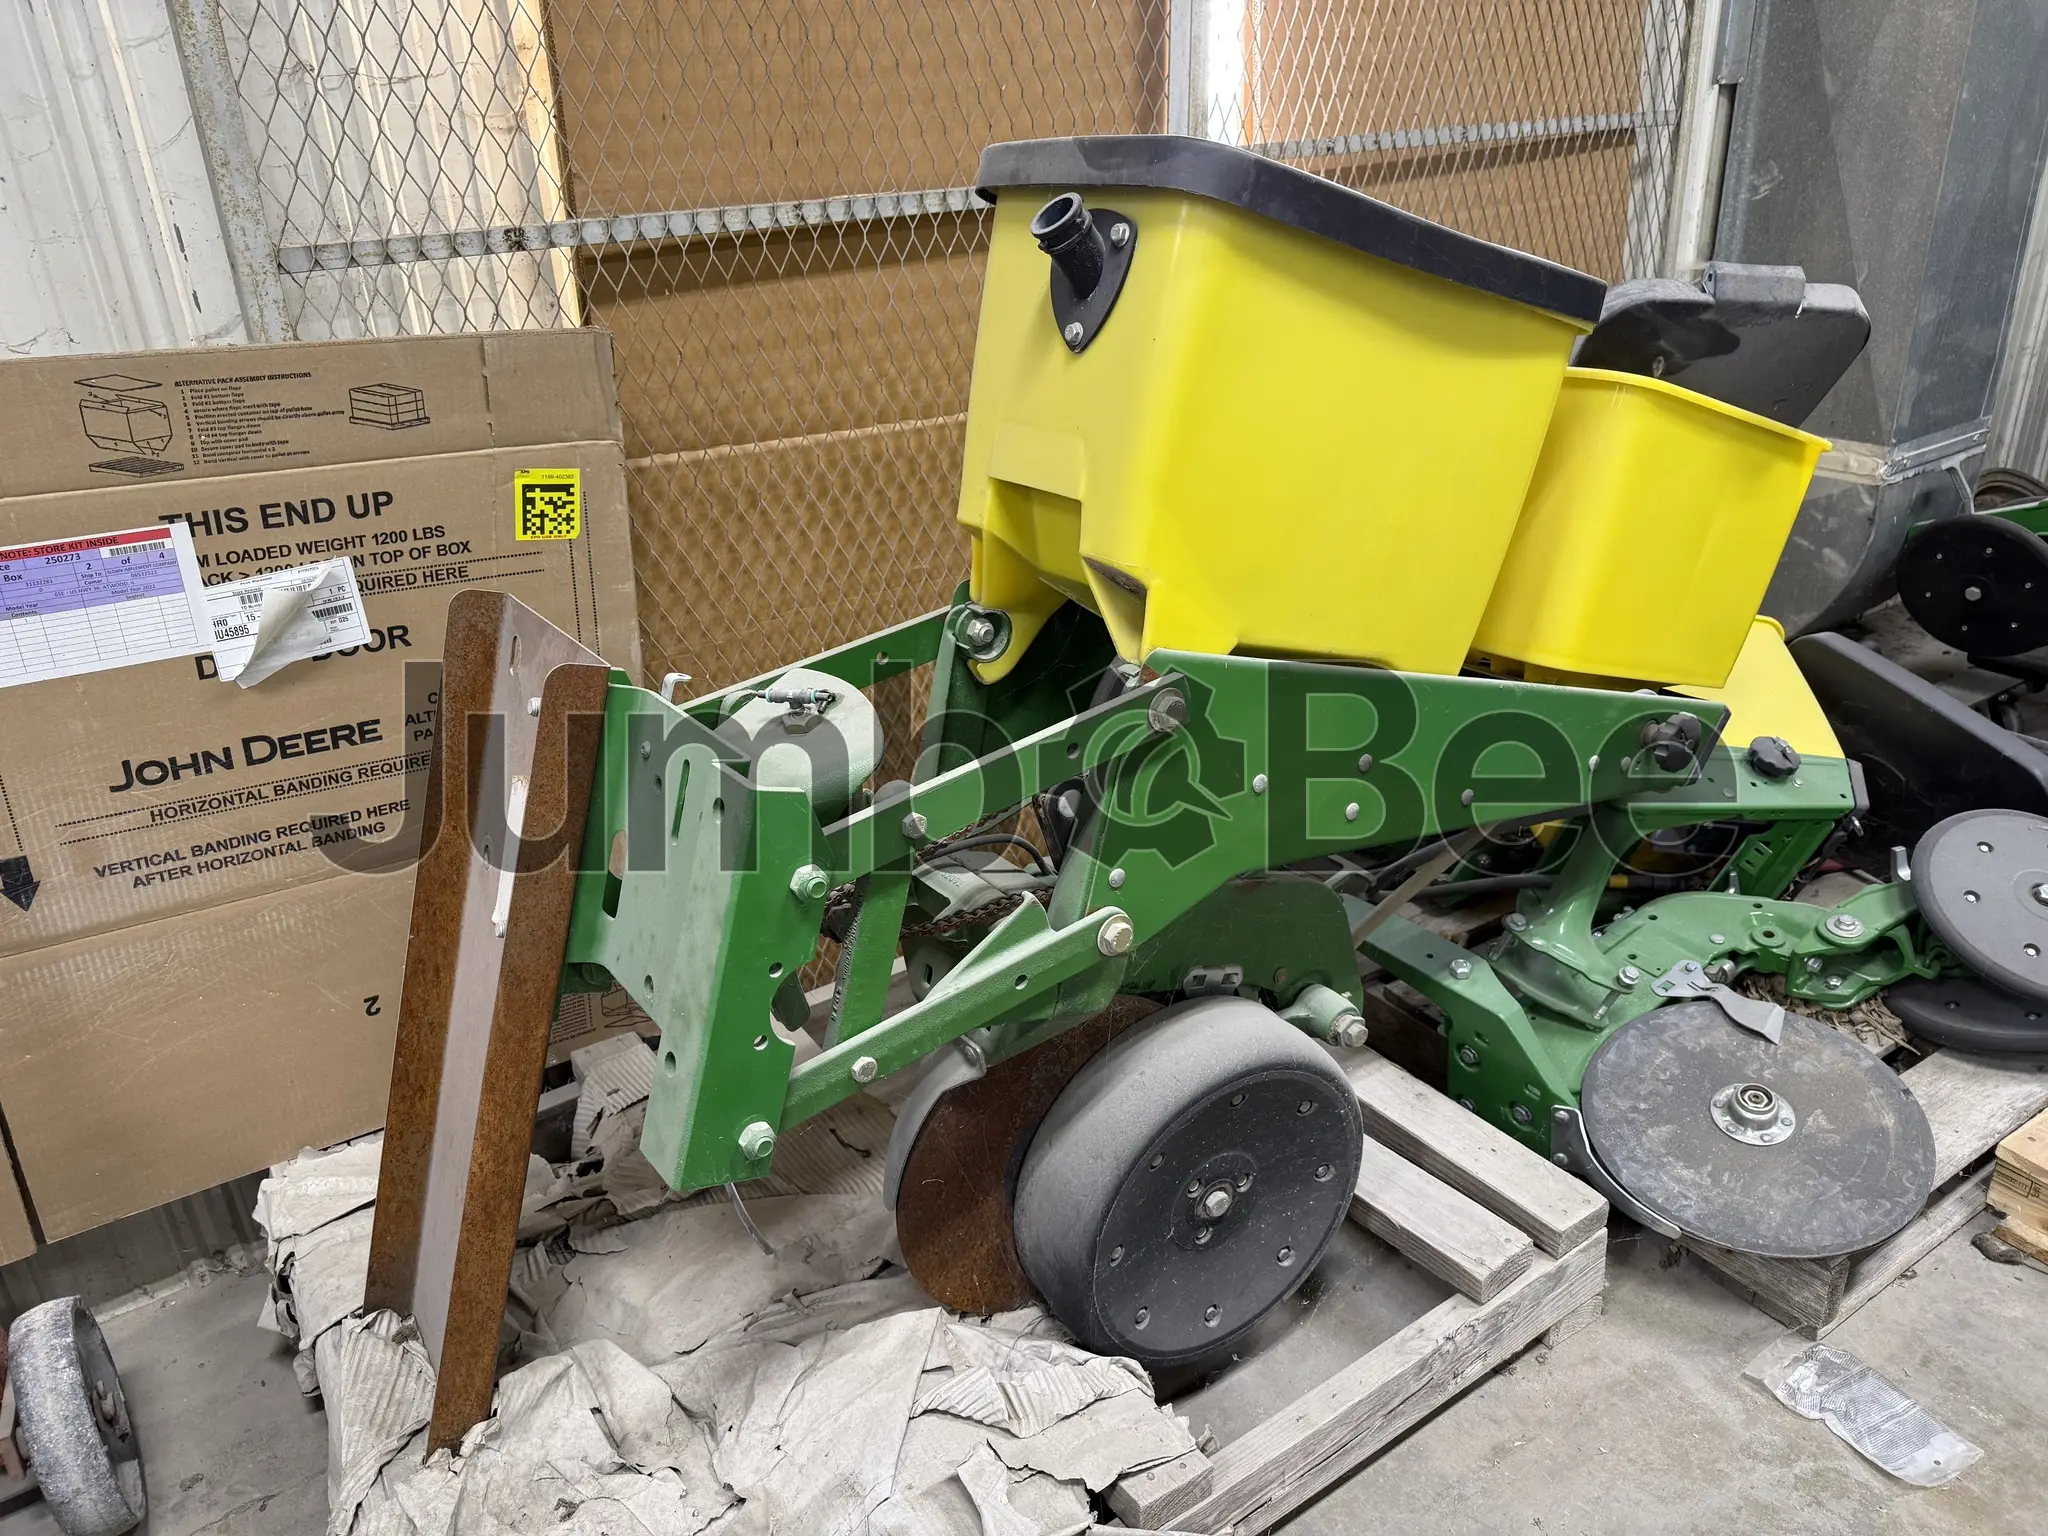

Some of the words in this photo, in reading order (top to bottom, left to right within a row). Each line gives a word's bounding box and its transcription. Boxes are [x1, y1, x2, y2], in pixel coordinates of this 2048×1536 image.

[234, 375, 266, 383] ASSEMBLY
[267, 372, 312, 380] INSTRUCTIONS
[158, 507, 250, 538] THIS
[259, 497, 336, 529] END
[346, 491, 394, 519] UP
[0, 549, 31, 560] NOTE:
[33, 544, 68, 556] STORE
[69, 541, 85, 550] KIT
[86, 536, 119, 548] INSIDE
[214, 544, 292, 566] LOADED
[295, 534, 366, 555] WEIGHT
[371, 529, 408, 546] 1200
[412, 525, 446, 541] LBS
[369, 550, 404, 565] TOP
[408, 546, 432, 561] OF
[436, 540, 472, 557] BOX
[3, 573, 23, 582] Box
[85, 562, 92, 570] 2
[121, 556, 132, 565] of
[44, 552, 81, 565] 250273
[123, 564, 152, 573] IMPLEMENT
[152, 560, 178, 568] COMPANY
[422, 565, 469, 584] HERE
[337, 585, 346, 593] PC
[405, 710, 436, 727] ALT
[108, 746, 235, 793] JOHN
[240, 718, 384, 767] DEERE
[149, 788, 270, 823] HORIZONTAL
[273, 770, 353, 797] BANDING
[94, 849, 187, 878] VERTICAL
[190, 830, 272, 857] BANDING
[276, 809, 362, 839] REQUIRED
[366, 799, 410, 819] HERE
[132, 865, 194, 889] AFTER
[196, 840, 308, 874] HORIZONTAL
[311, 821, 386, 848] BANDING
[364, 995, 381, 1016] 2
